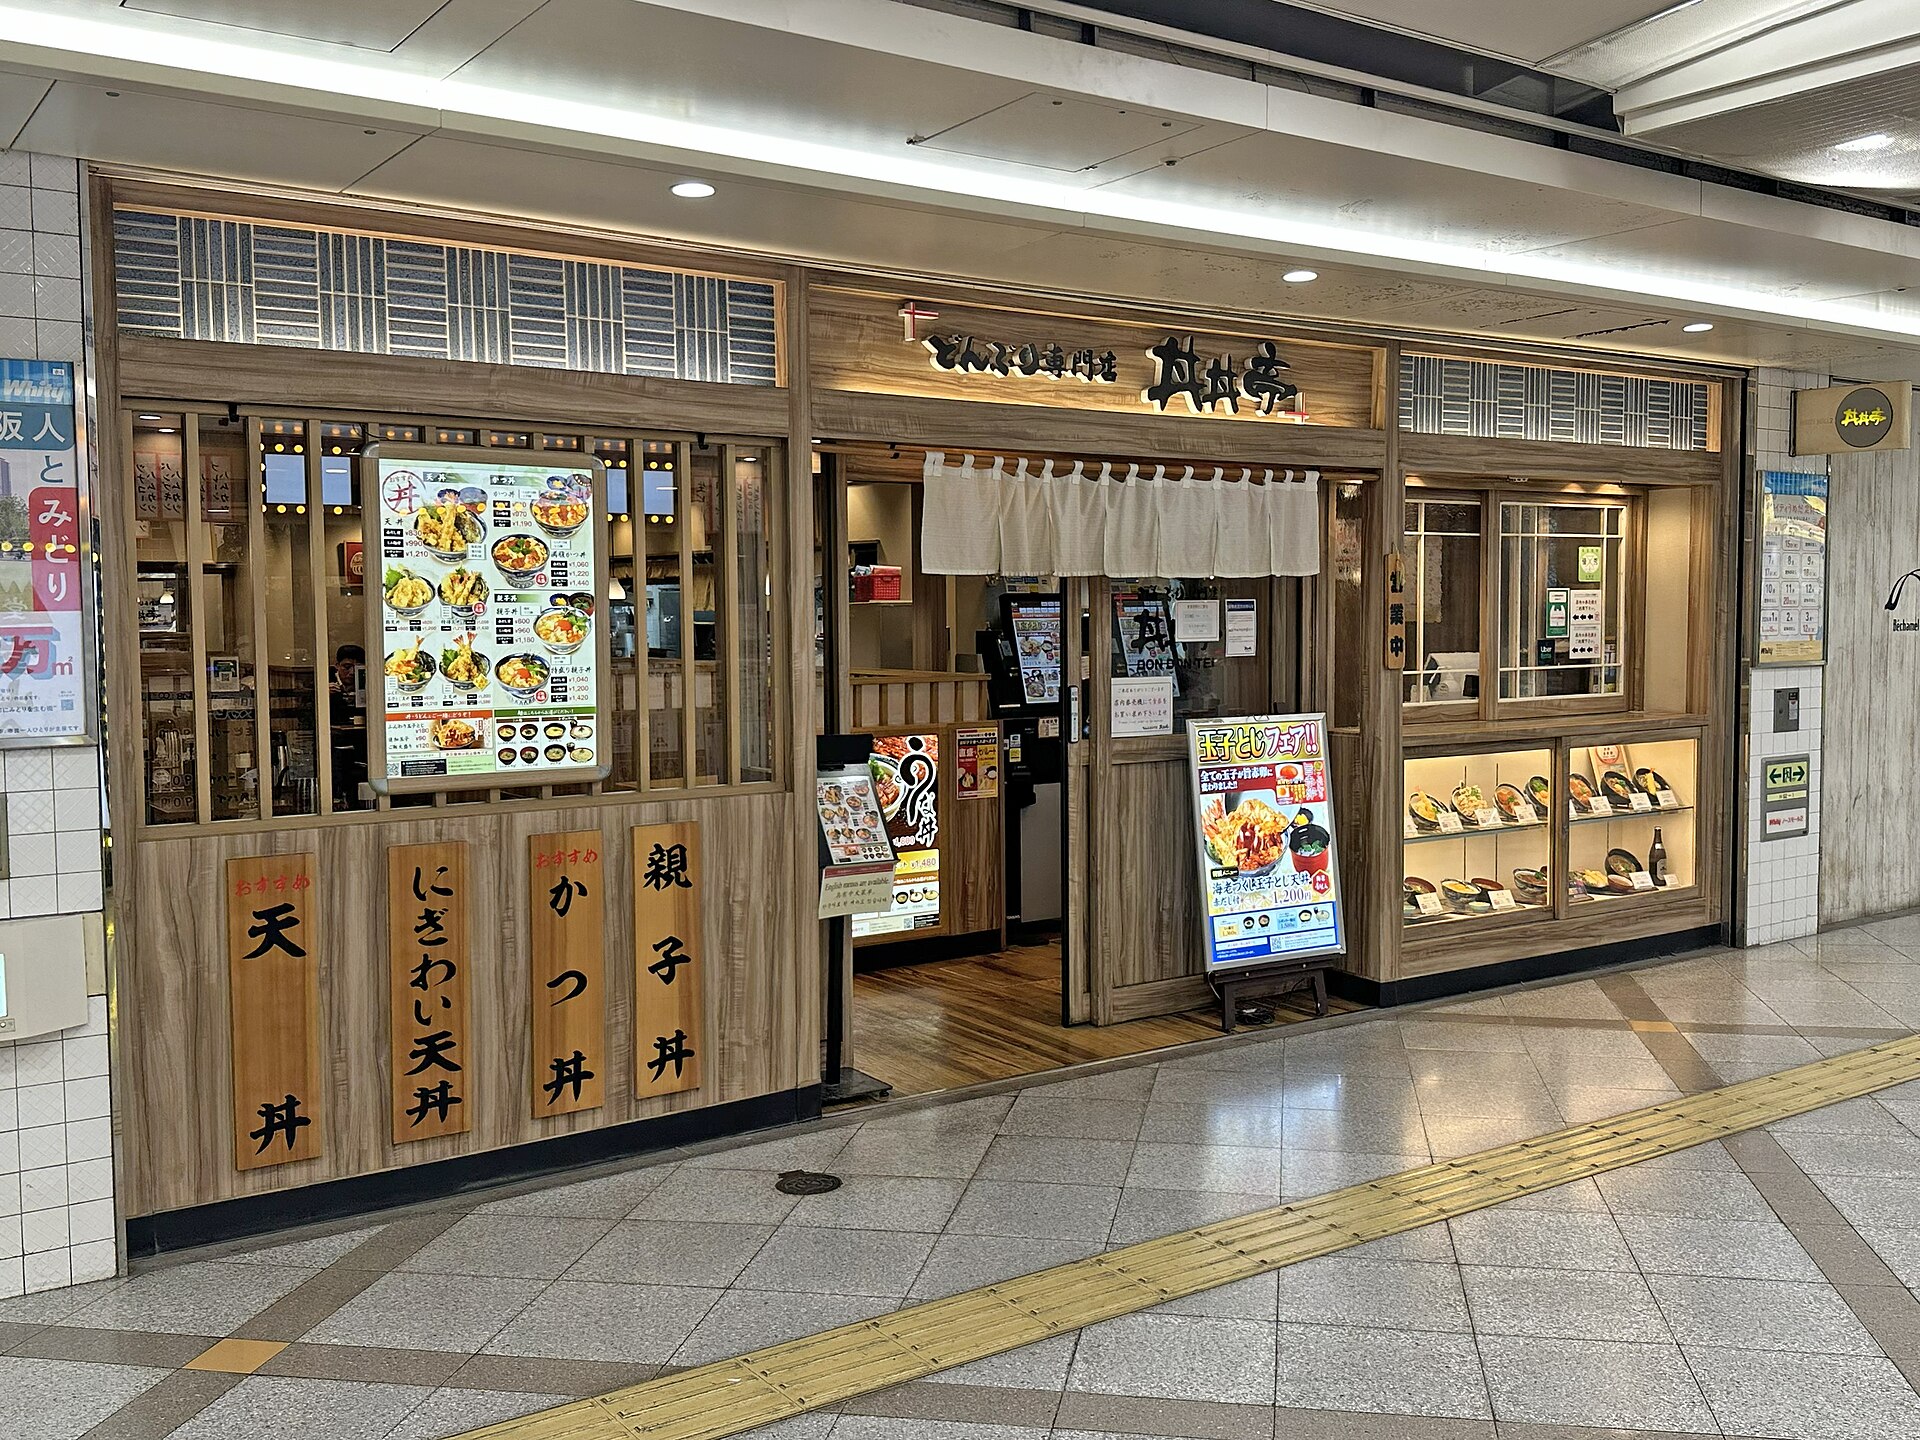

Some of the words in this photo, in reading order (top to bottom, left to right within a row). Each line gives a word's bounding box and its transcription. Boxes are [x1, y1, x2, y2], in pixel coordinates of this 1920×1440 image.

[921, 334, 1117, 384] どんぶり専門店
[1141, 334, 1299, 417] 丼丼亭
[3, 379, 65, 402] Whity
[426, 473, 447, 482] 天丼
[384, 518, 404, 526] 天丼
[1540, 645, 1553, 653] Uber
[535, 849, 598, 870] おすすめ
[234, 873, 312, 898] おすすめ
[825, 882, 843, 892] English
[1272, 887, 1313, 904] 1,200円
[642, 843, 696, 1085] 親子丼
[403, 866, 463, 1128] にぎわい天丼
[541, 875, 596, 1107] かつ丼
[242, 902, 312, 1156] 天丼
